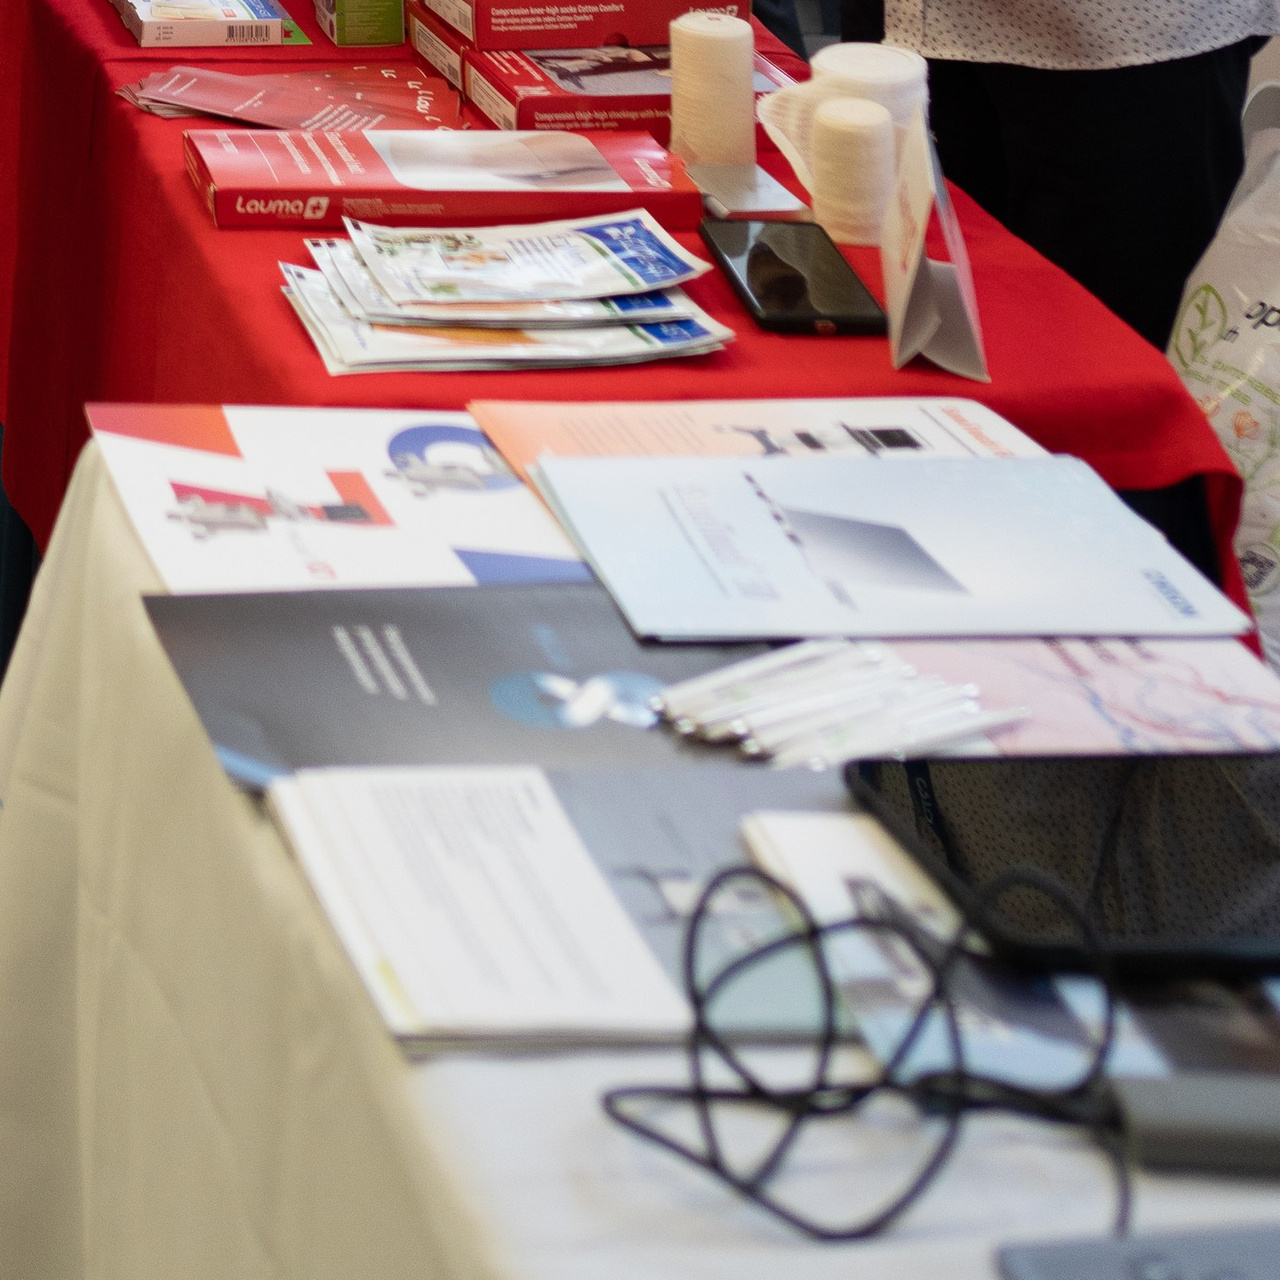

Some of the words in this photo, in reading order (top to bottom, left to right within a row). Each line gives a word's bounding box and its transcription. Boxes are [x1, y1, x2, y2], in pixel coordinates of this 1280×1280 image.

[491, 6, 529, 17] Compression
[578, 4, 599, 13] Cotton
[599, 3, 625, 13] Comfort
[534, 111, 575, 121] Compression
[235, 195, 304, 215] Lauma
